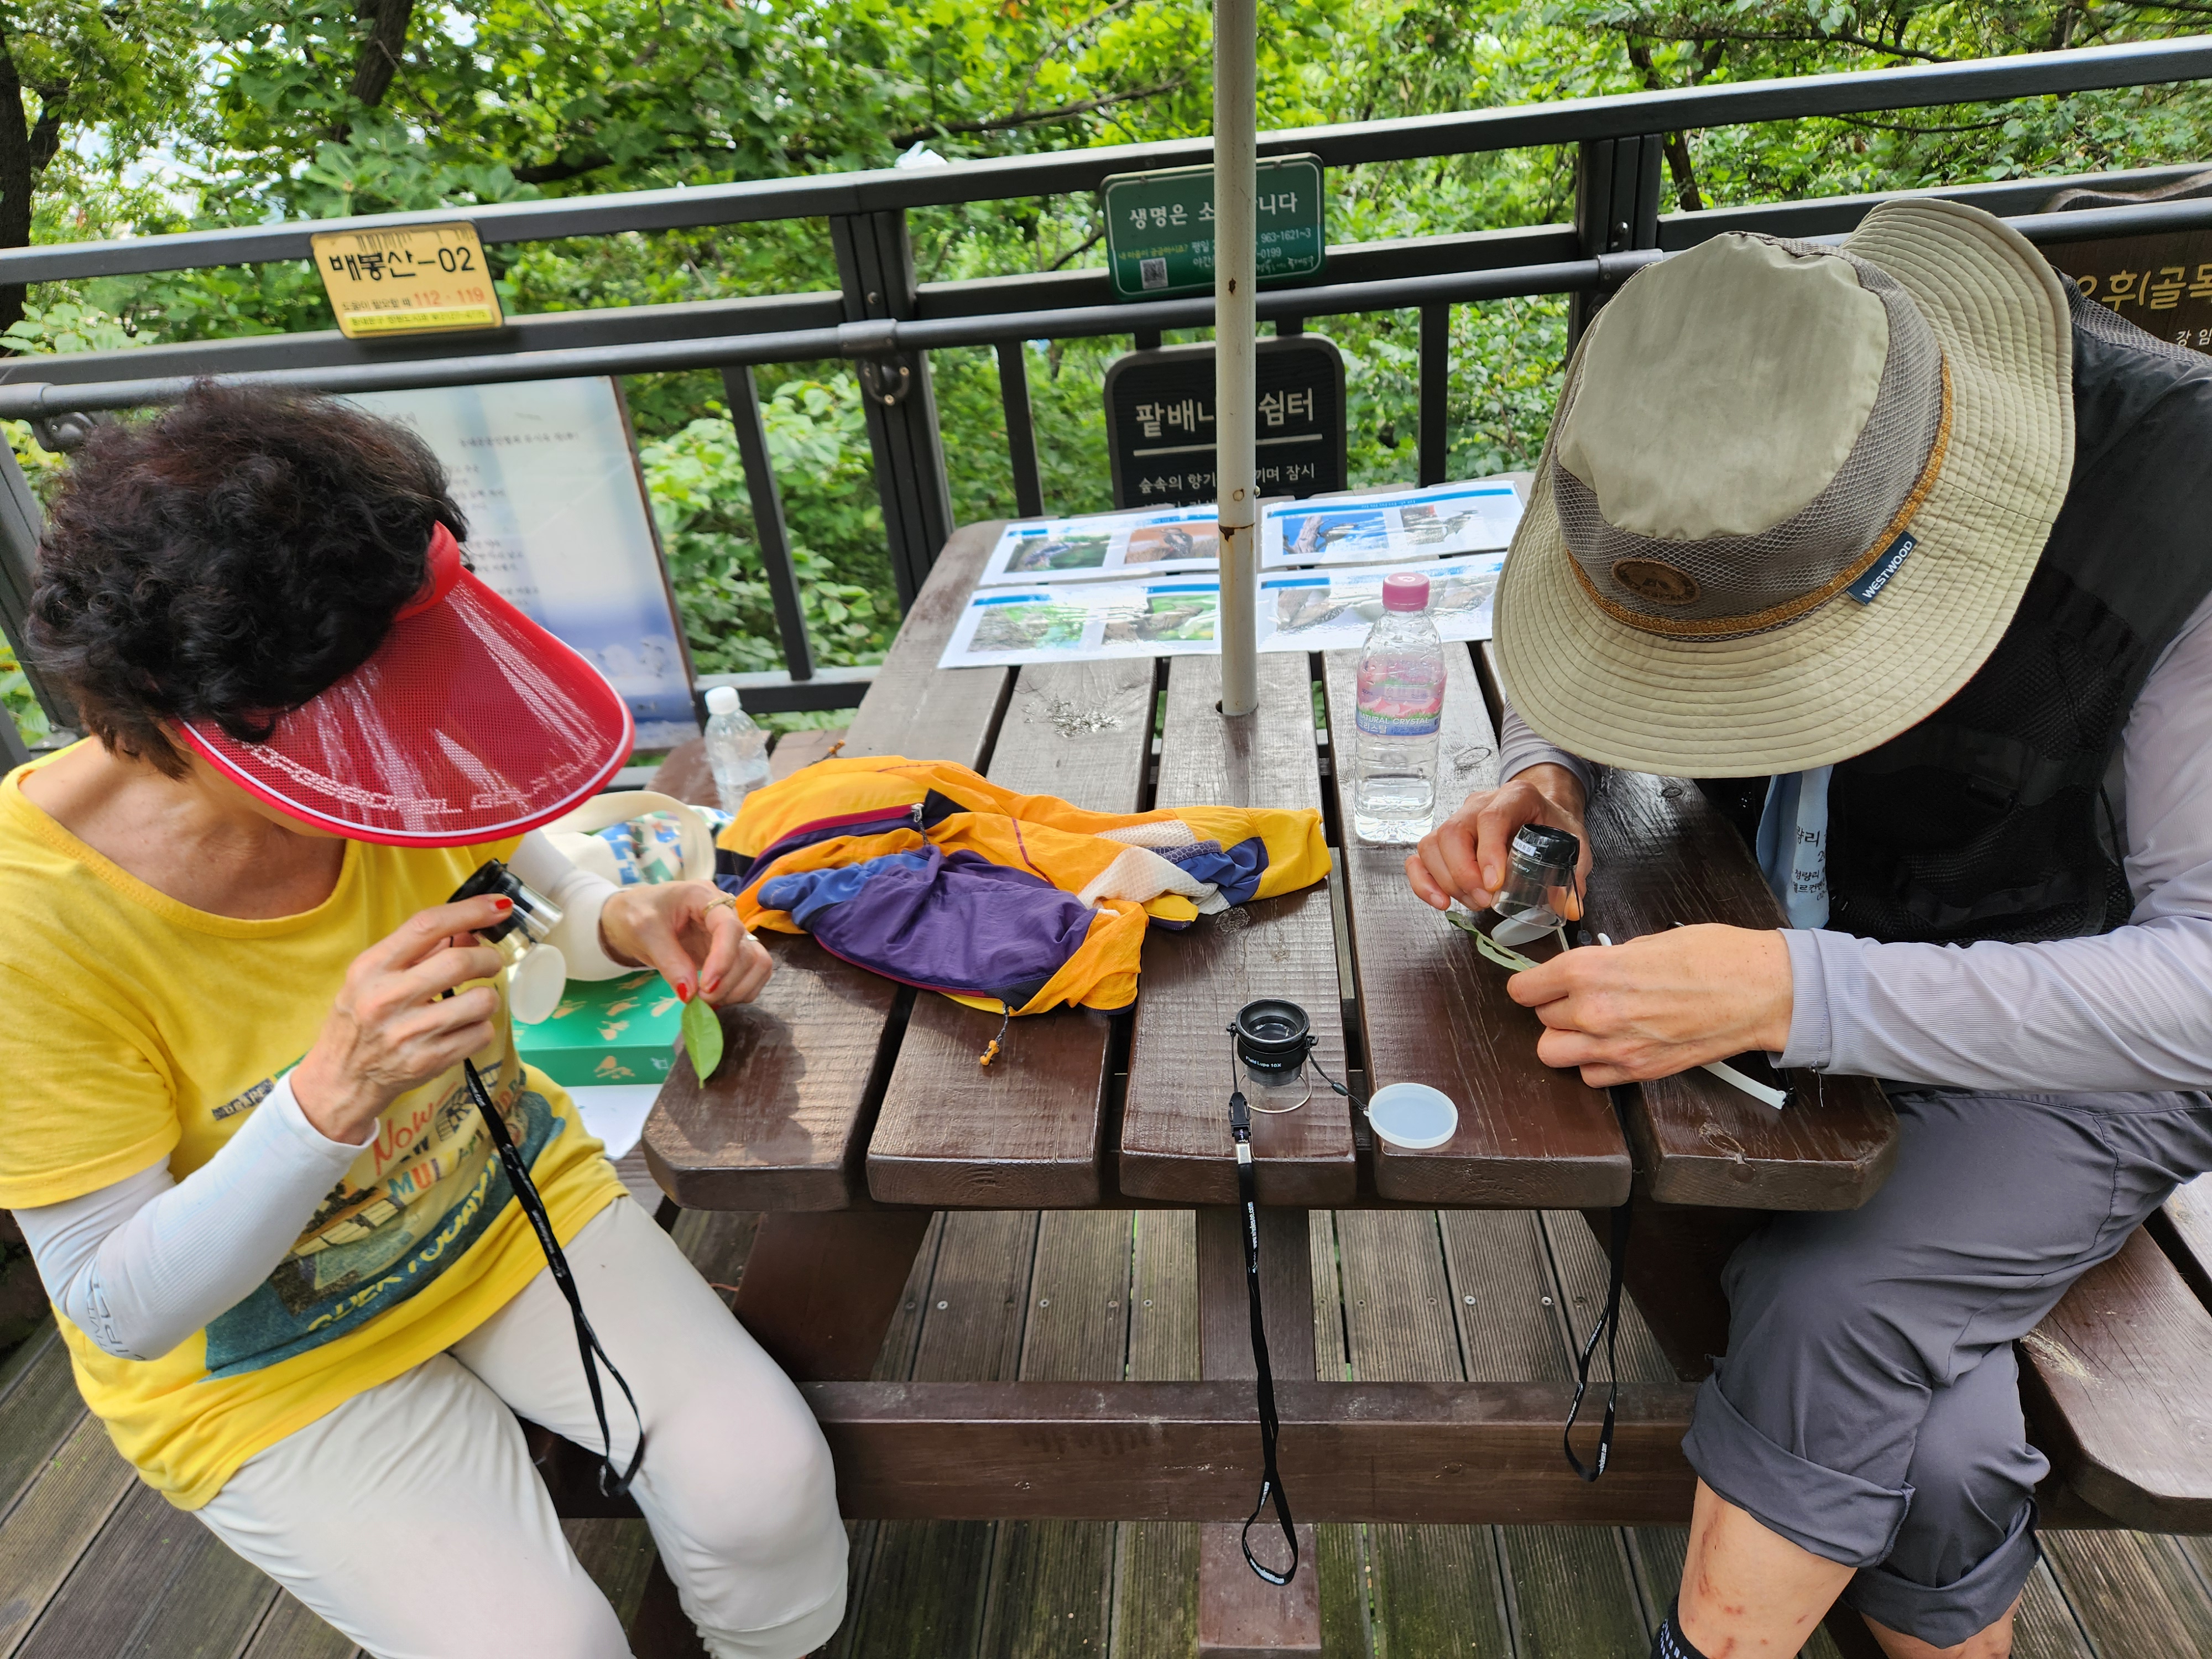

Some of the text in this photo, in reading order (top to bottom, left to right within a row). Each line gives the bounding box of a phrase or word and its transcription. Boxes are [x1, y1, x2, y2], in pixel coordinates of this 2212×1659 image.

[1129, 191, 1298, 230] 생명은 소니다
[328, 246, 476, 281] 배봉산-02
[414, 289, 441, 306] 112
[456, 286, 486, 304] 119
[2176, 329, 2192, 347] 강
[1258, 387, 1314, 426] 쉼터
[1139, 462, 1315, 494] 숲속의 향기 끼며 잠시
[1862, 540, 1913, 599] WESTWOOD
[1358, 719, 1387, 734] 크리스탈
[1359, 710, 1390, 725] NATURAL
[1392, 717, 1430, 726] CRYSTAL
[1797, 825, 1820, 848] 량리
[1518, 864, 1530, 873] Story
[1794, 868, 1820, 881] 청량리
[1245, 1055, 1257, 1065] Field
[373, 1102, 434, 1177] Now
